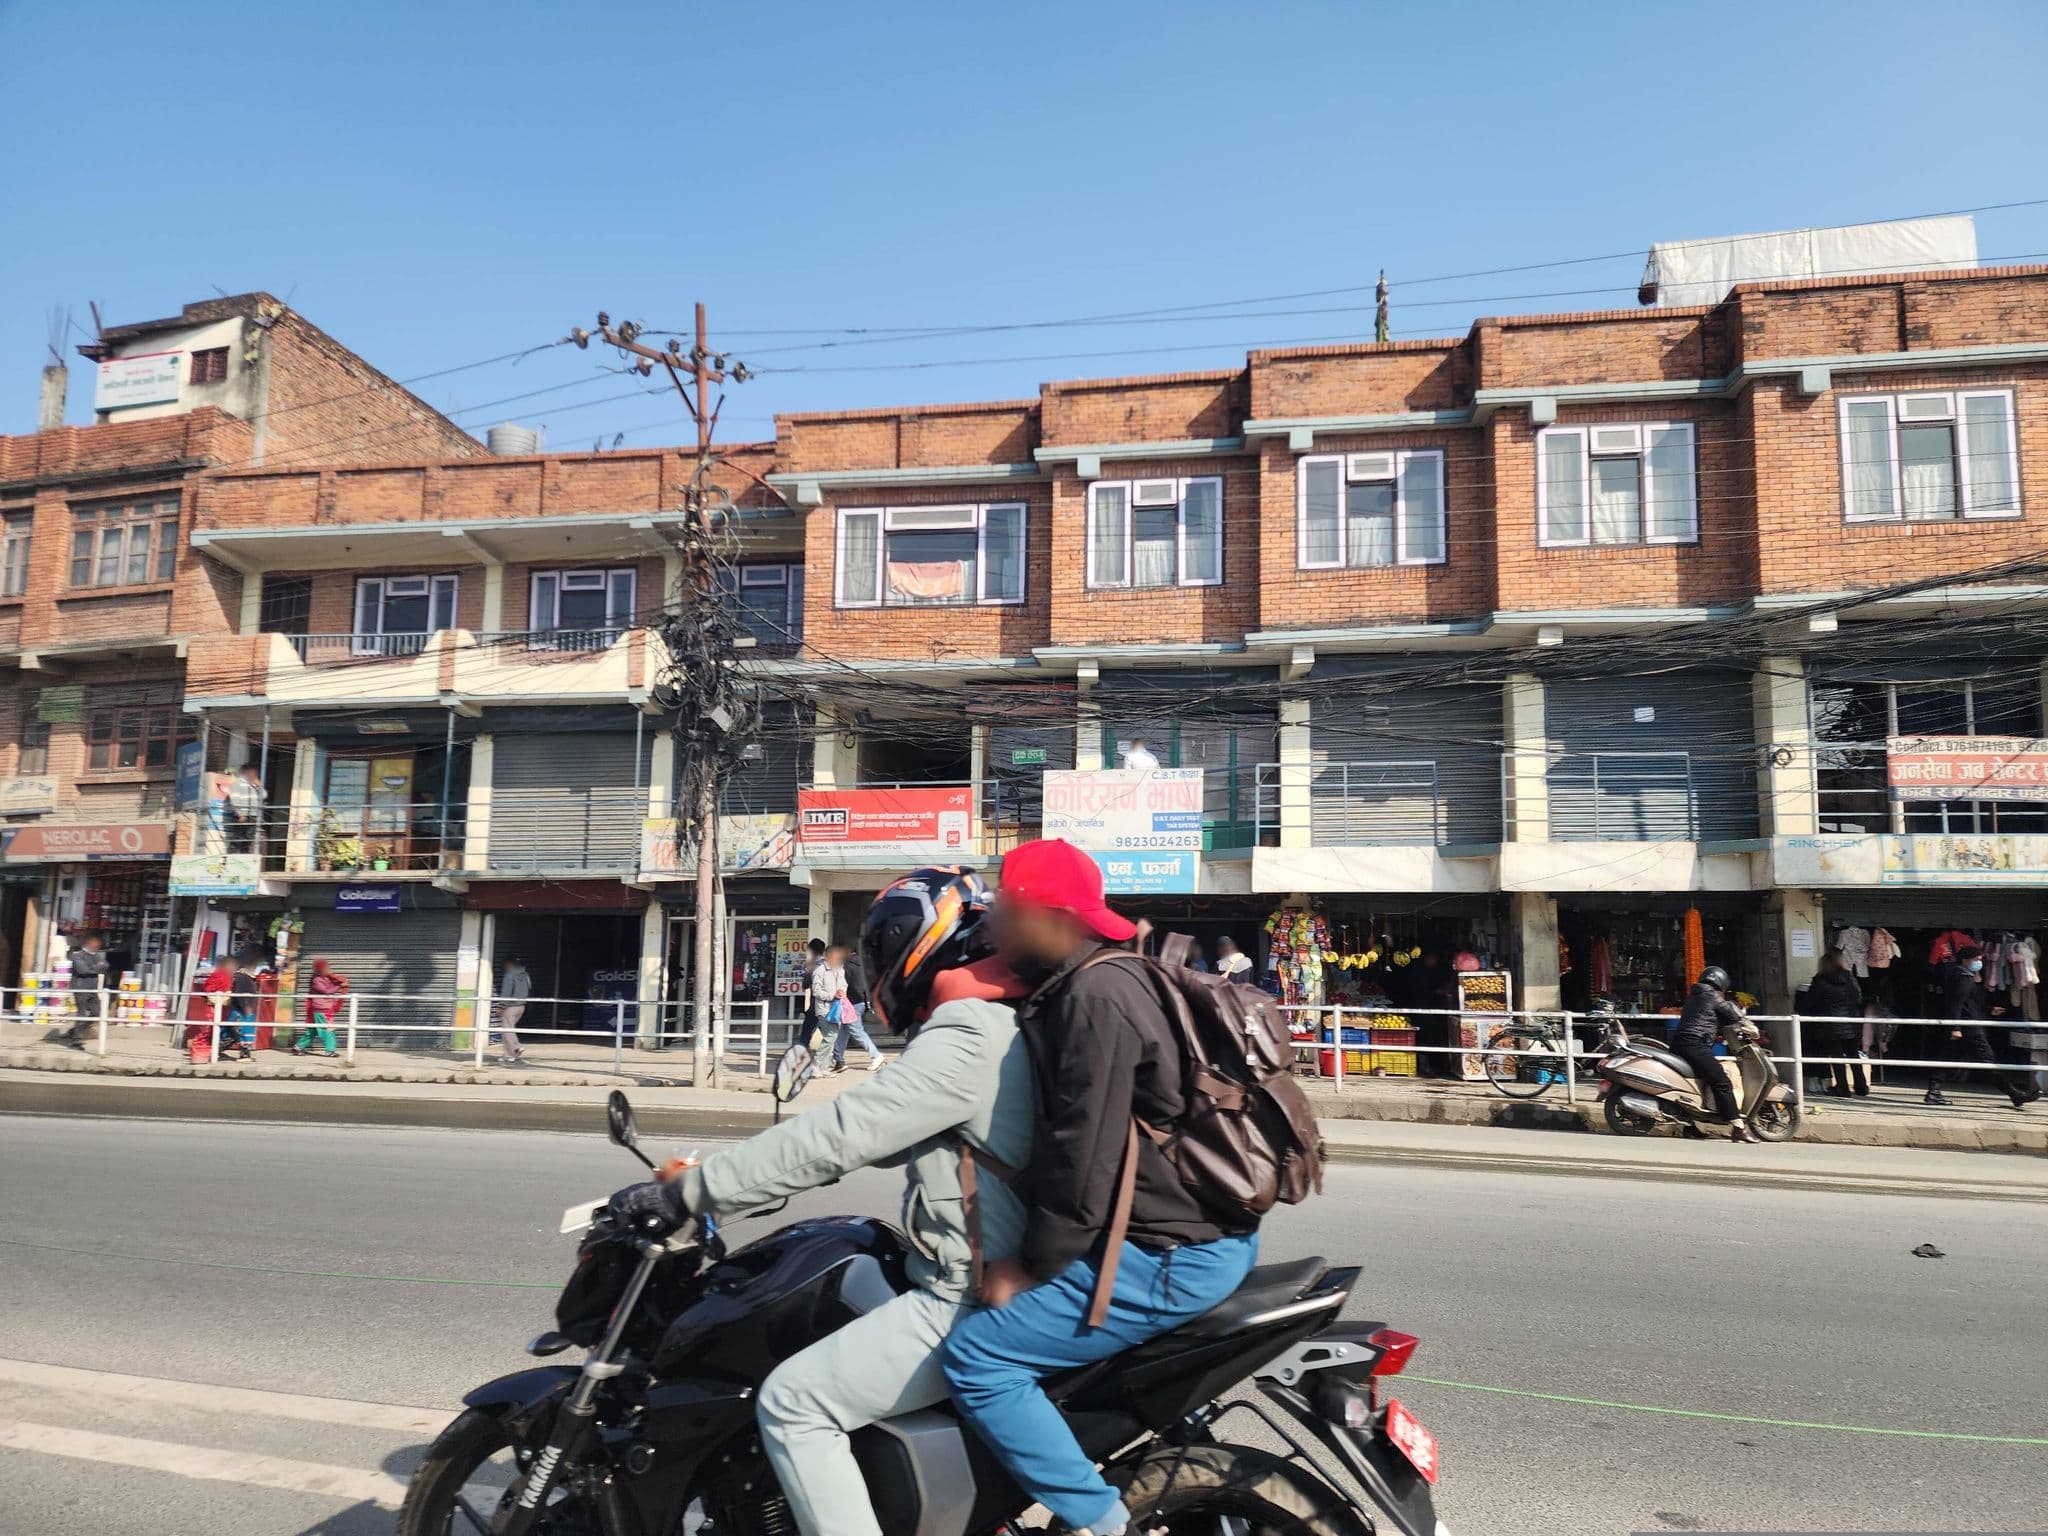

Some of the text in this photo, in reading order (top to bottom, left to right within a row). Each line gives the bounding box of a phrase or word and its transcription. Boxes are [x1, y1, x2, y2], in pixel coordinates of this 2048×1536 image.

[1891, 757, 1952, 780] जनसेवा
[1956, 762, 1985, 780] जब
[1045, 776, 1200, 811] कोरियन भाषा
[810, 813, 845, 825] IME
[42, 829, 110, 845] NEROLAC
[1116, 836, 1200, 847] 9823024263
[518, 1445, 563, 1509] YAMAHA
